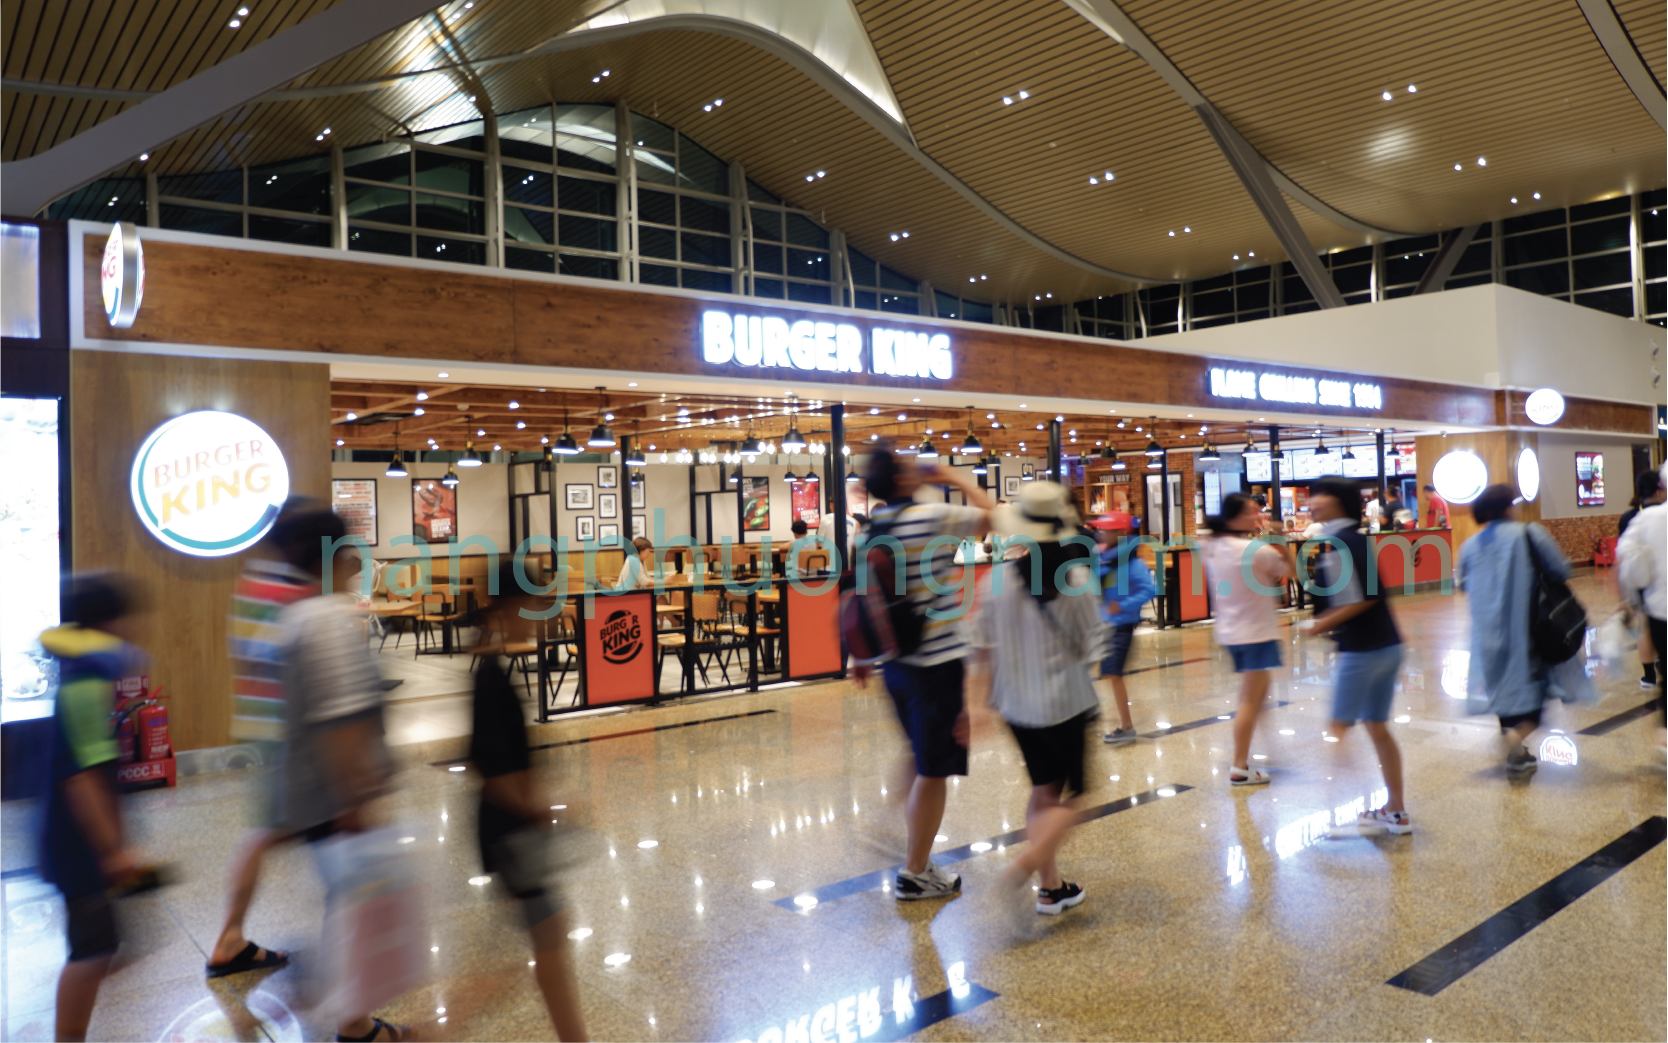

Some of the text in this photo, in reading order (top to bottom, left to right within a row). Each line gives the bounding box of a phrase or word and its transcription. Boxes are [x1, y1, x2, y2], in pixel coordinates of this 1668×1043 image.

[703, 310, 953, 379] BURGER KING
[154, 439, 264, 489] BURGER
[1115, 474, 1130, 482] WAY
[162, 462, 271, 525] KING
[600, 615, 640, 640] BURGR
[603, 625, 641, 654] KING
[117, 765, 150, 780] PCCC
